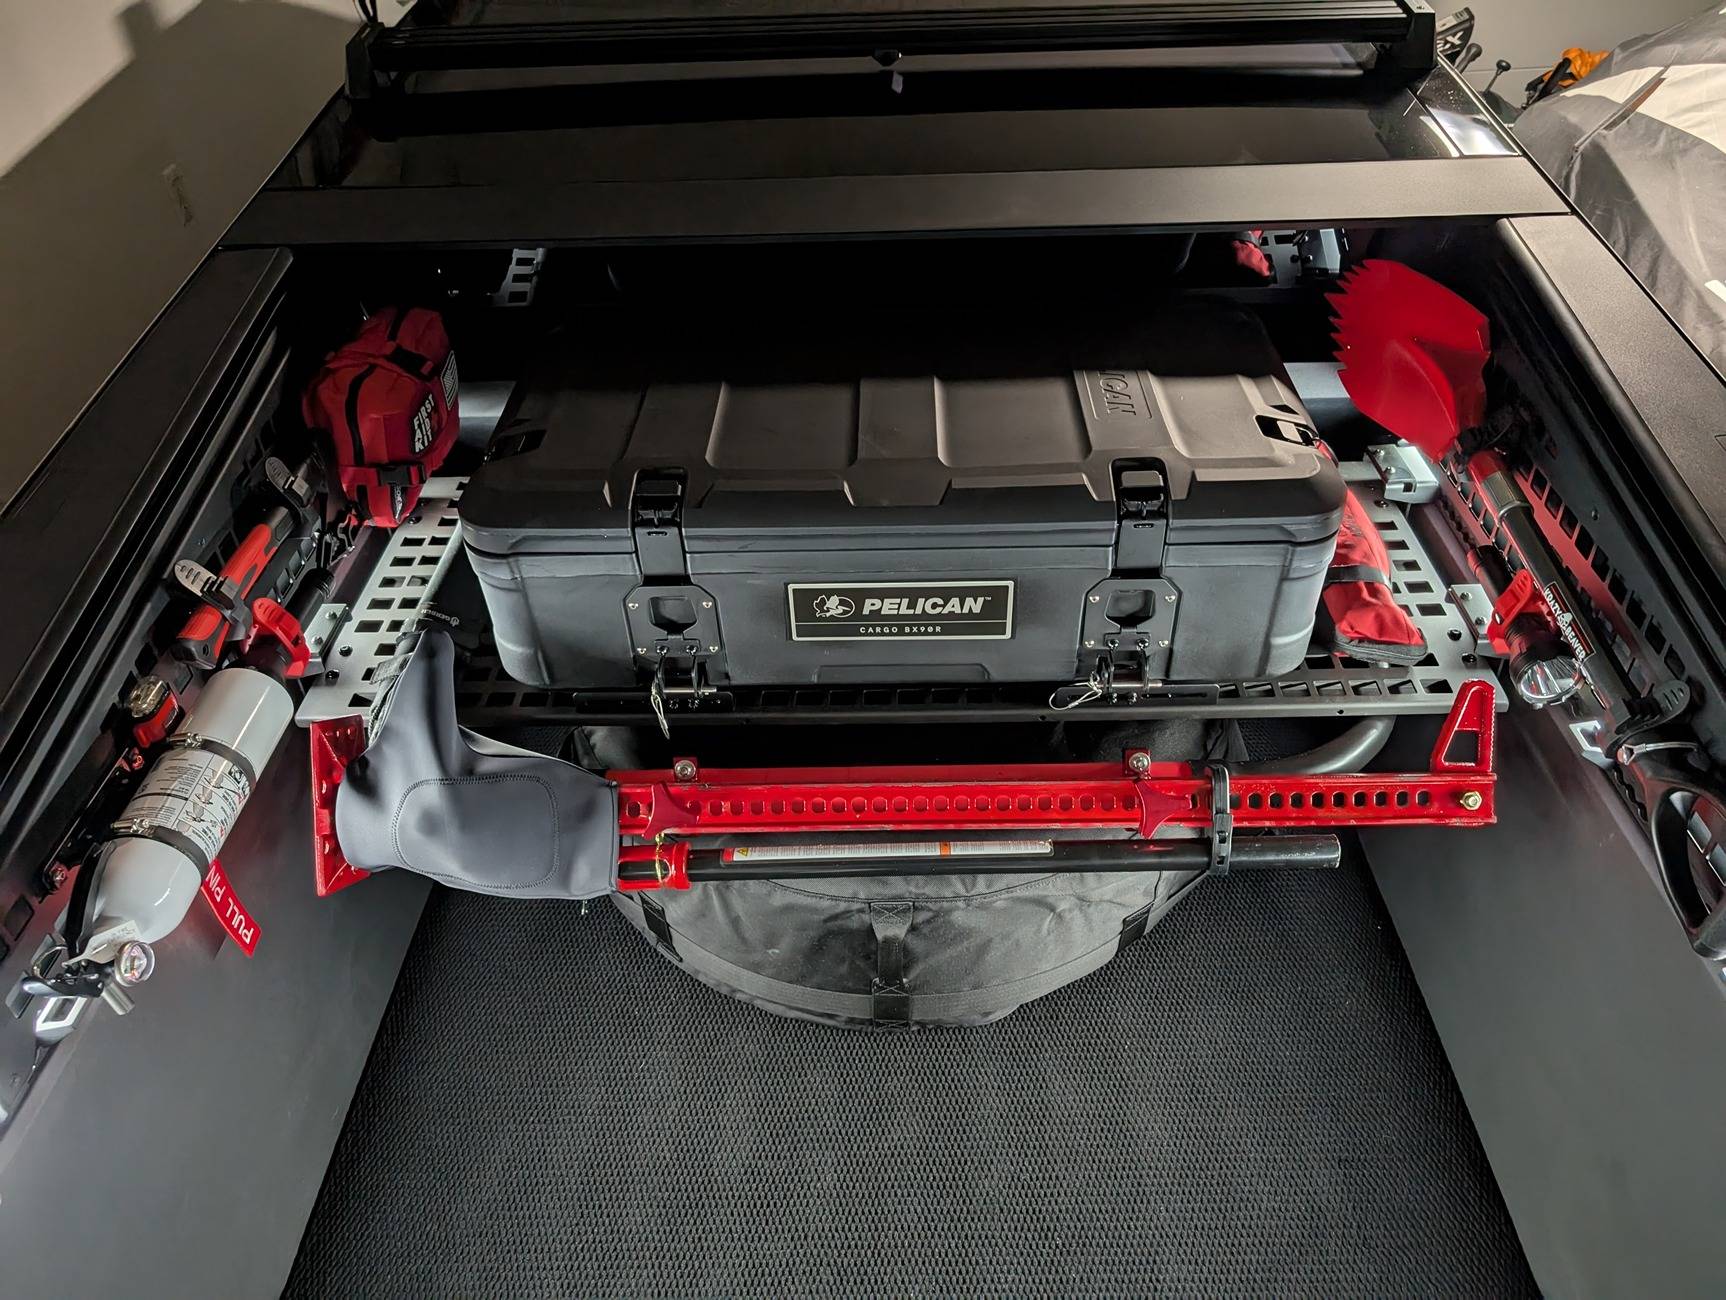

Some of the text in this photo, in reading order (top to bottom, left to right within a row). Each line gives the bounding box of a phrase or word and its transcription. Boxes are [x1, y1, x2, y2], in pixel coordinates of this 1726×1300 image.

[414, 394, 434, 430] FIRST
[415, 418, 431, 441] AID
[415, 429, 432, 452] KIT
[859, 626, 898, 634] CARGO
[1544, 588, 1586, 661] KRAZY BEAVER
[205, 865, 226, 903] PIN
[226, 897, 254, 945] PULL
